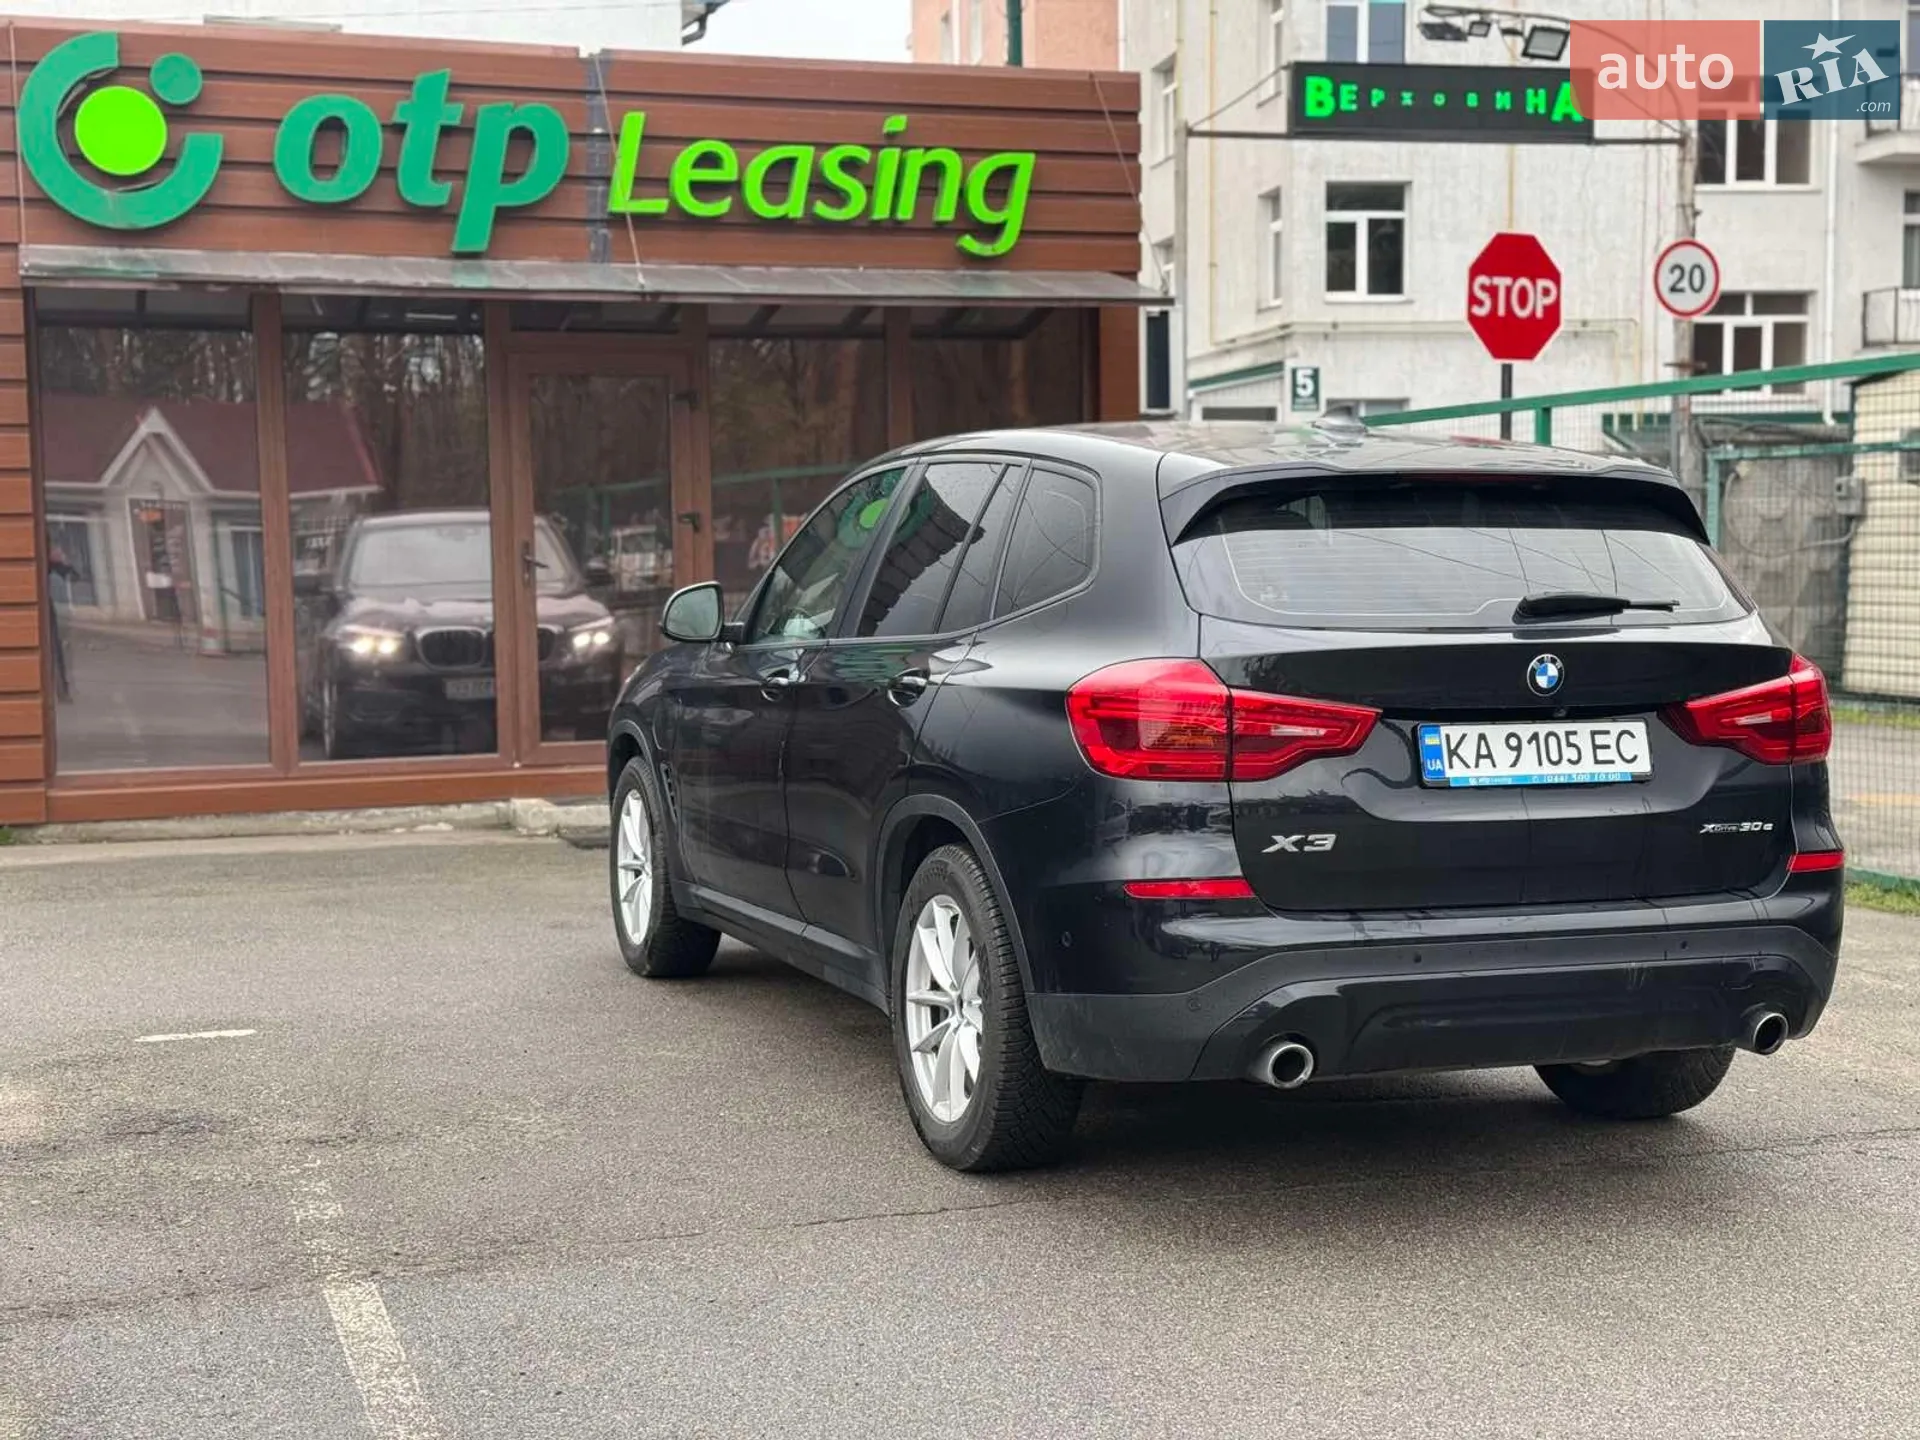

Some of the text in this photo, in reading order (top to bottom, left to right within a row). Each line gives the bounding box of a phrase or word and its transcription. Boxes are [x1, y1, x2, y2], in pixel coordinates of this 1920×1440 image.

[273, 68, 1036, 257] otp Leasing
[1668, 263, 1706, 293] 20
[1471, 274, 1558, 319] STOP
[1296, 369, 1315, 397] 5
[1427, 758, 1444, 771] UA
[1444, 729, 1639, 770] KA 9105 EC
[1261, 834, 1337, 853] X3
